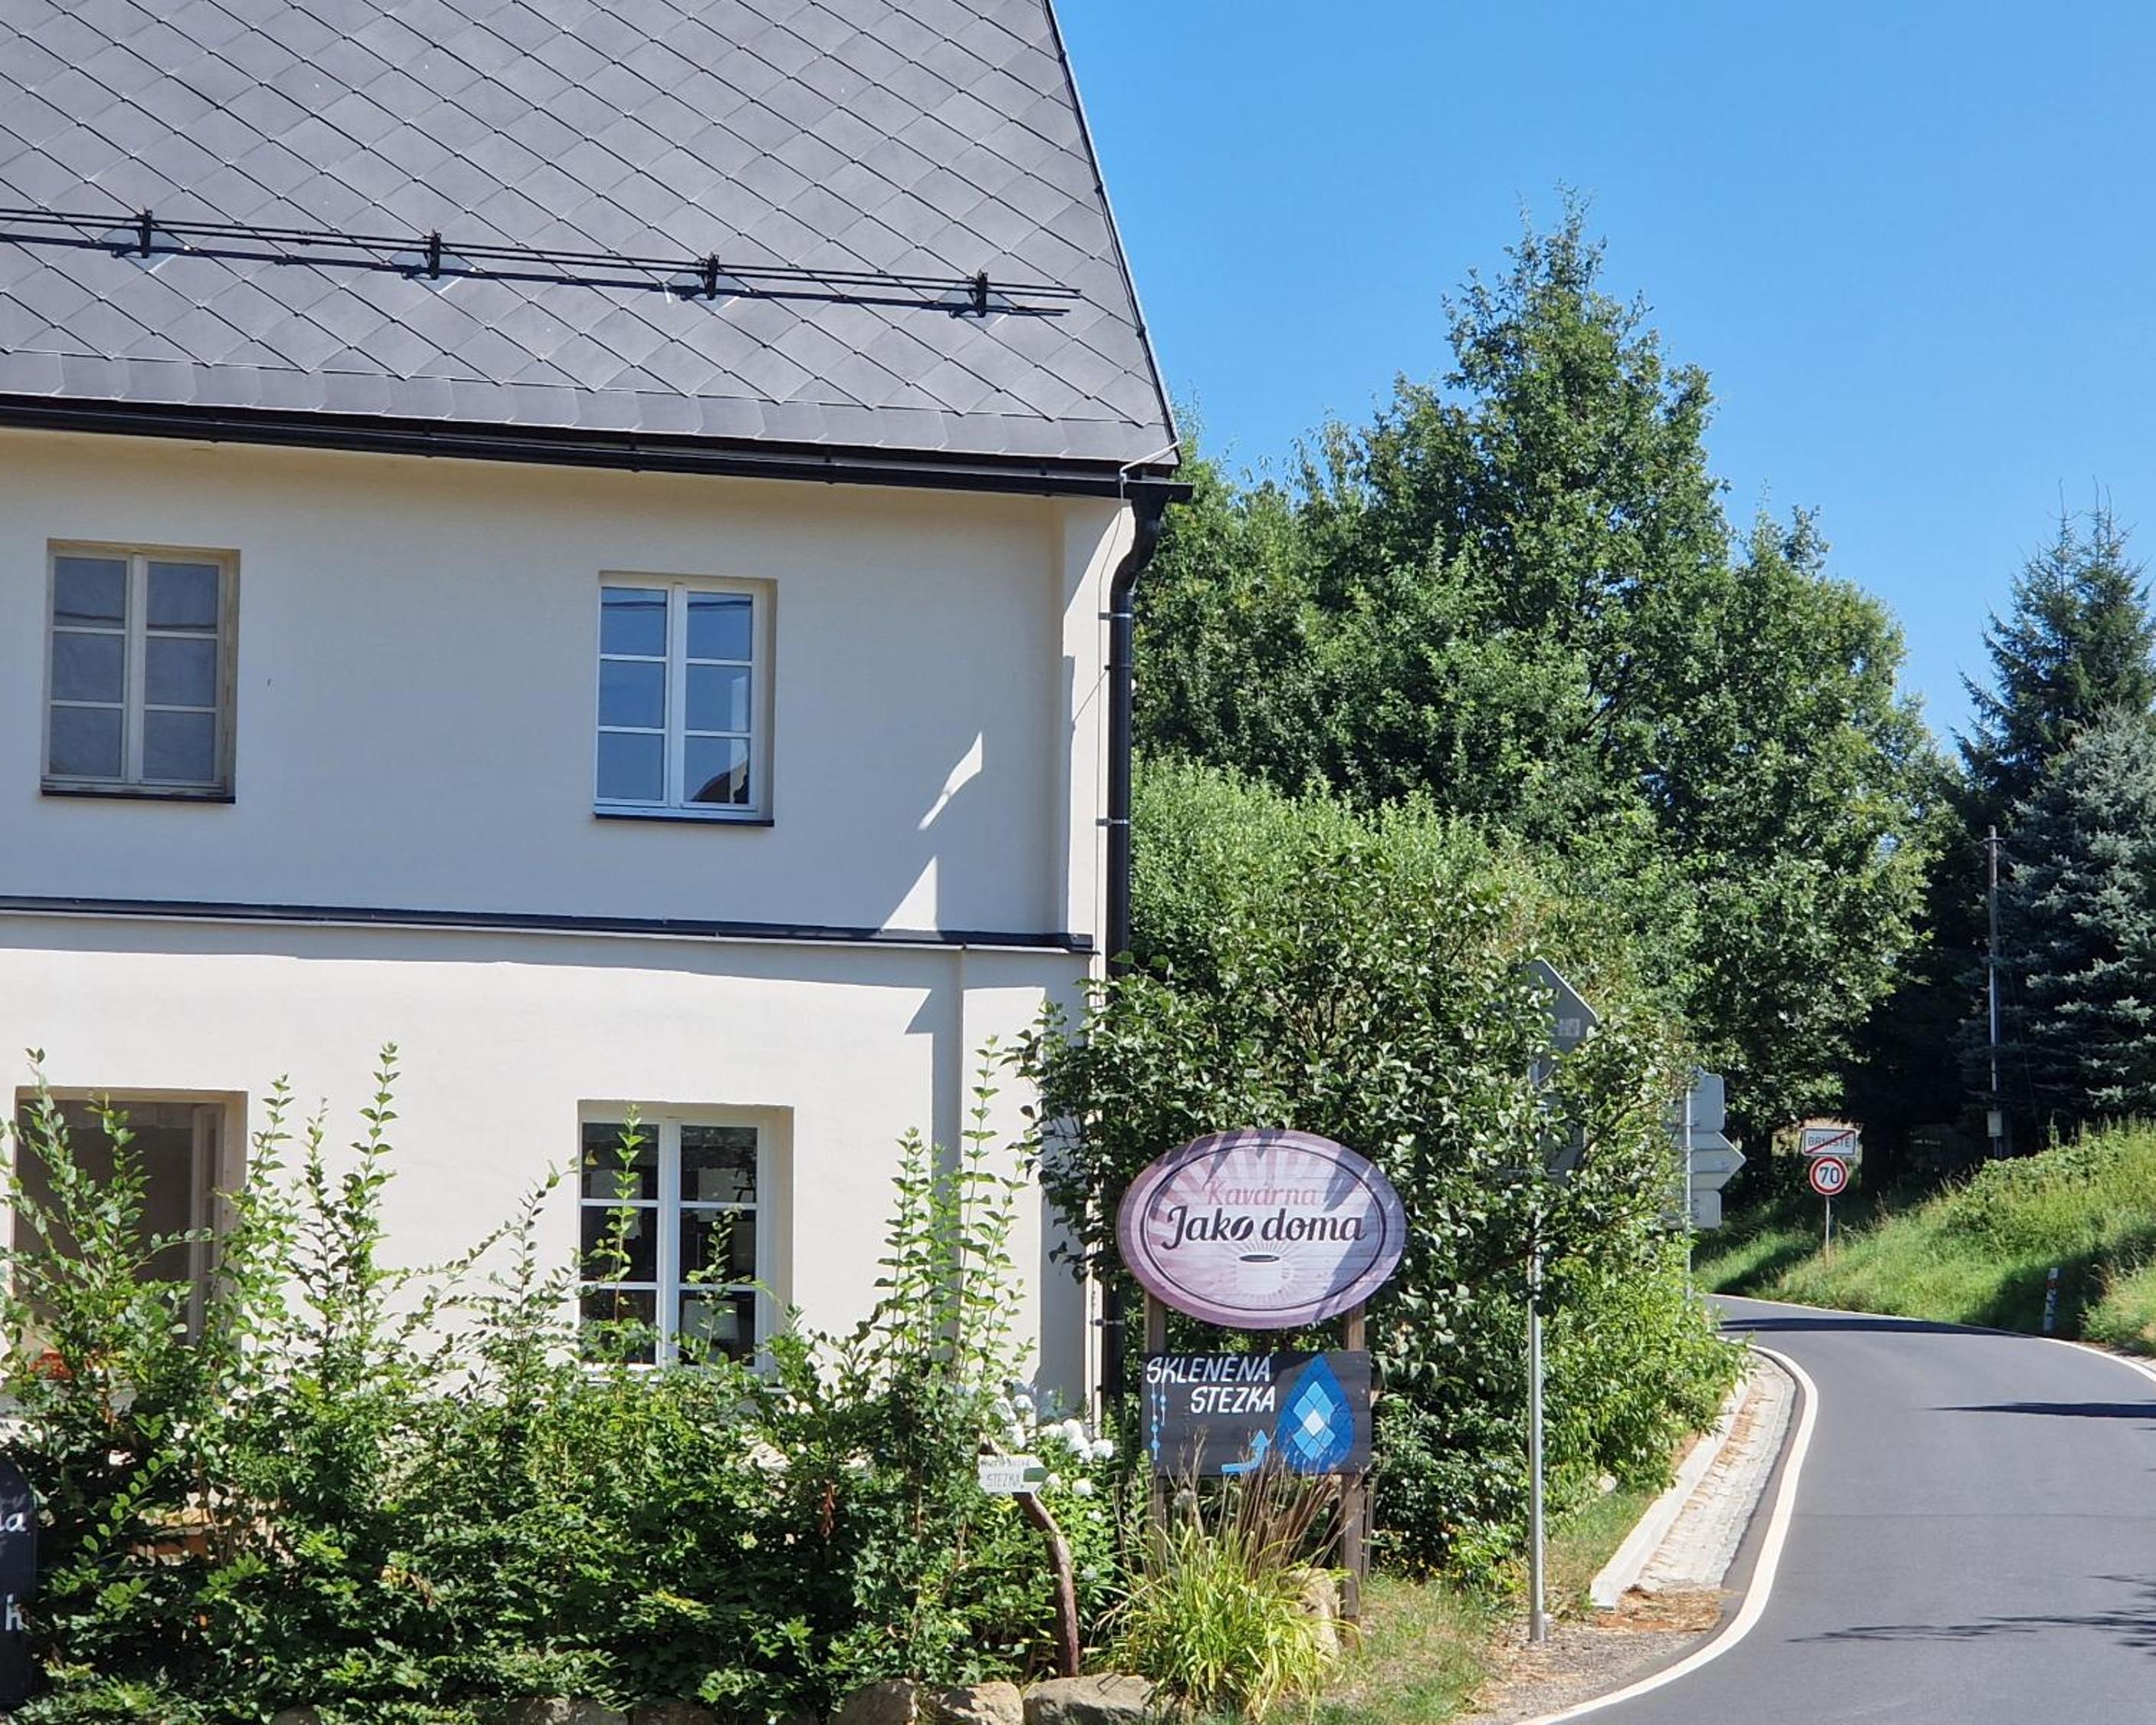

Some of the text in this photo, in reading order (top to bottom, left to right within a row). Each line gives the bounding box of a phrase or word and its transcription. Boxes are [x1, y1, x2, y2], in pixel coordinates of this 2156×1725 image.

[1820, 1167, 1840, 1183] 70
[1207, 1180, 1317, 1206] Kavárna
[1161, 1206, 1368, 1250] Jako doma
[1190, 1385, 1276, 1414] STEZKA
